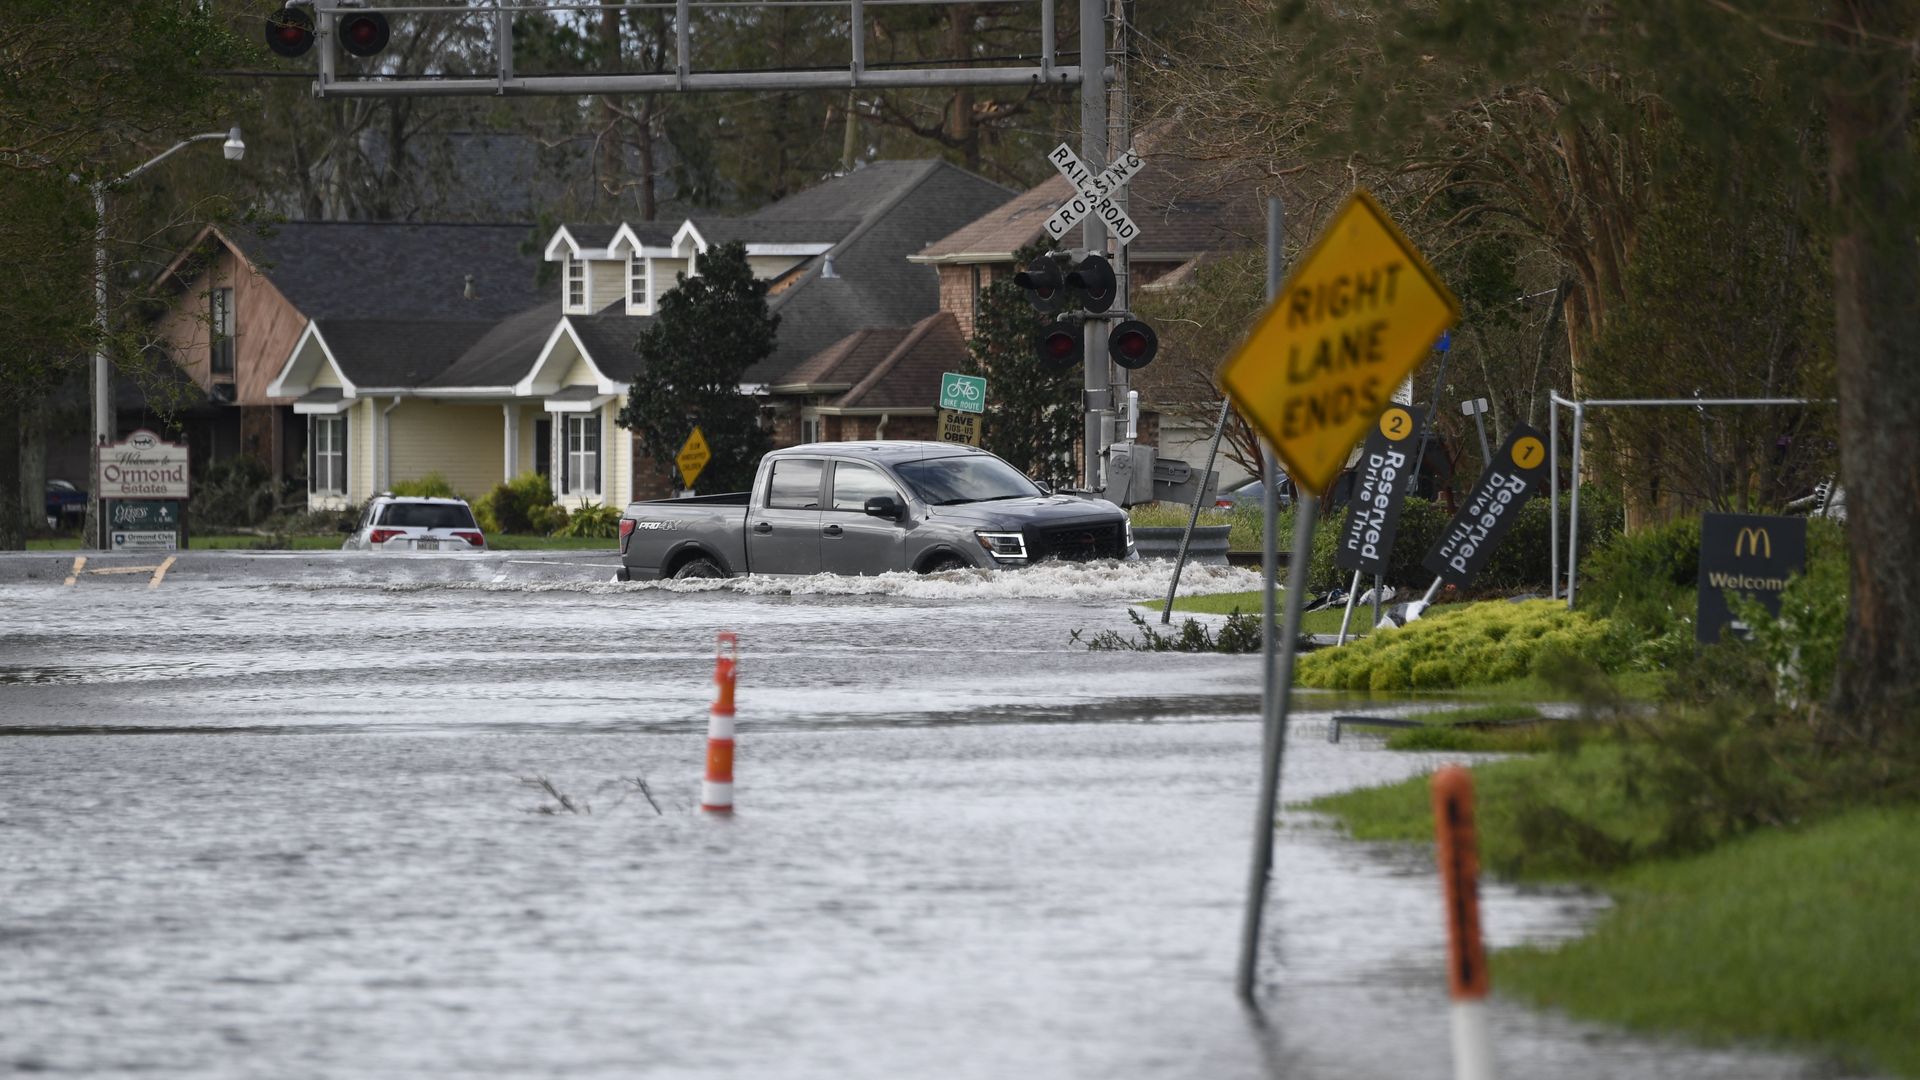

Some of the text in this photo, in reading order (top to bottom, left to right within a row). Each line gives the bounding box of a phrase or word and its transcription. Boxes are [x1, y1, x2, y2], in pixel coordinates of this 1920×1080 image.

[1286, 261, 1402, 330] RIGHT
[1286, 320, 1388, 385] LANE
[943, 398, 980, 411] BIKE ROUTE
[946, 414, 974, 427] SAVE
[1281, 374, 1380, 438] ENDS
[1389, 415, 1404, 434] 2
[944, 432, 973, 444] OBEY
[1521, 445, 1535, 461] 1
[104, 464, 184, 484] Ormond
[121, 484, 168, 494] Estates
[1347, 454, 1384, 551] Drive Thru
[1361, 450, 1405, 561] Reserved
[1439, 472, 1505, 558] Drive Thru
[1450, 474, 1526, 574] Reserved
